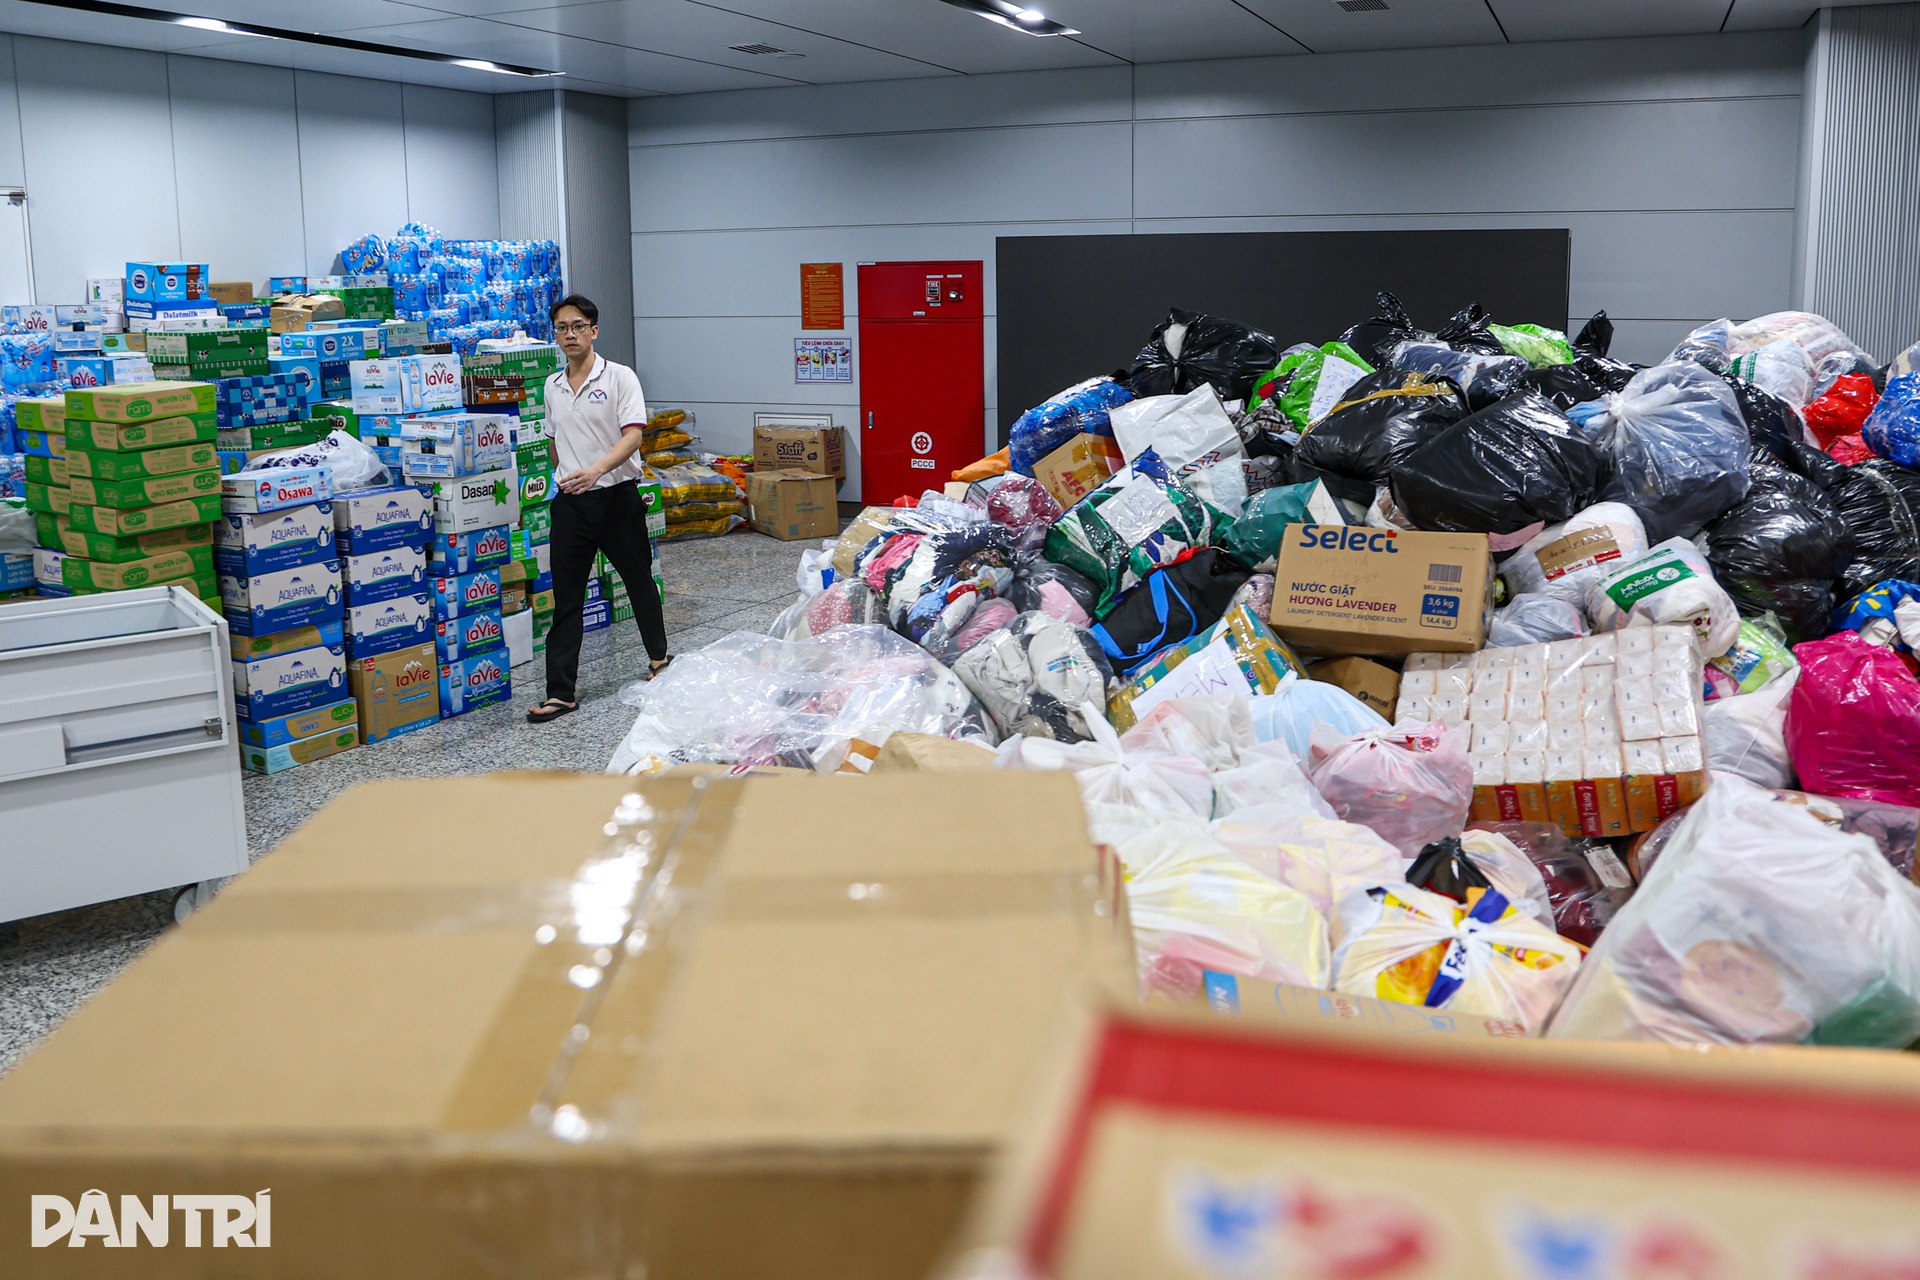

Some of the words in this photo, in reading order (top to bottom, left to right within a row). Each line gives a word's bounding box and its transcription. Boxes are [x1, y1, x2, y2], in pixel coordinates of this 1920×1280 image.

[163, 310, 198, 318] Dalatmilk
[342, 336, 354, 346] 2X
[70, 372, 96, 386] laVie
[425, 370, 454, 386] laVie
[127, 403, 151, 414] Fami
[125, 429, 146, 438] Fami
[478, 430, 504, 447] laVie
[777, 440, 804, 456] Staff
[912, 460, 934, 468] PCCC
[195, 476, 218, 487] Fami
[528, 482, 544, 494] MILO
[1061, 471, 1086, 497] AFC
[278, 486, 313, 501] Osawa
[461, 481, 497, 500] Dasani
[125, 513, 146, 522] Fami
[376, 508, 411, 524] AQUAFINA
[271, 525, 309, 542] AQUAFINA
[1300, 524, 1398, 553] Select
[475, 536, 506, 555] laVie
[124, 570, 147, 580] Fami
[372, 562, 405, 577] AQUAFINA
[465, 581, 497, 600] laVie
[1291, 582, 1327, 593] NƯỚC
[1330, 585, 1356, 596] GIẶT
[1621, 574, 1655, 595] XANH
[1638, 580, 1658, 591] Bách
[278, 584, 317, 602] AQUAFINA
[1624, 589, 1639, 598] hóa
[1289, 594, 1333, 607] HƯƠNG
[1336, 599, 1397, 612] LAVENDER
[1428, 598, 1442, 607] 3,6
[1443, 599, 1454, 609] kg
[375, 613, 408, 629] AQUAFINA
[1316, 610, 1352, 620] DETERGENT
[1353, 613, 1385, 622] LAVENDER
[1386, 616, 1407, 624] SCENT
[1426, 617, 1440, 625] 14,4
[1441, 618, 1452, 627] kg
[466, 622, 499, 641] laVie
[278, 667, 320, 687] AQUAFINA
[396, 668, 430, 687] laVie
[468, 666, 501, 686] laVie
[1584, 792, 1594, 812] TẶNG
[1665, 786, 1674, 804] TẶNG
[1586, 816, 1598, 832] MUA
